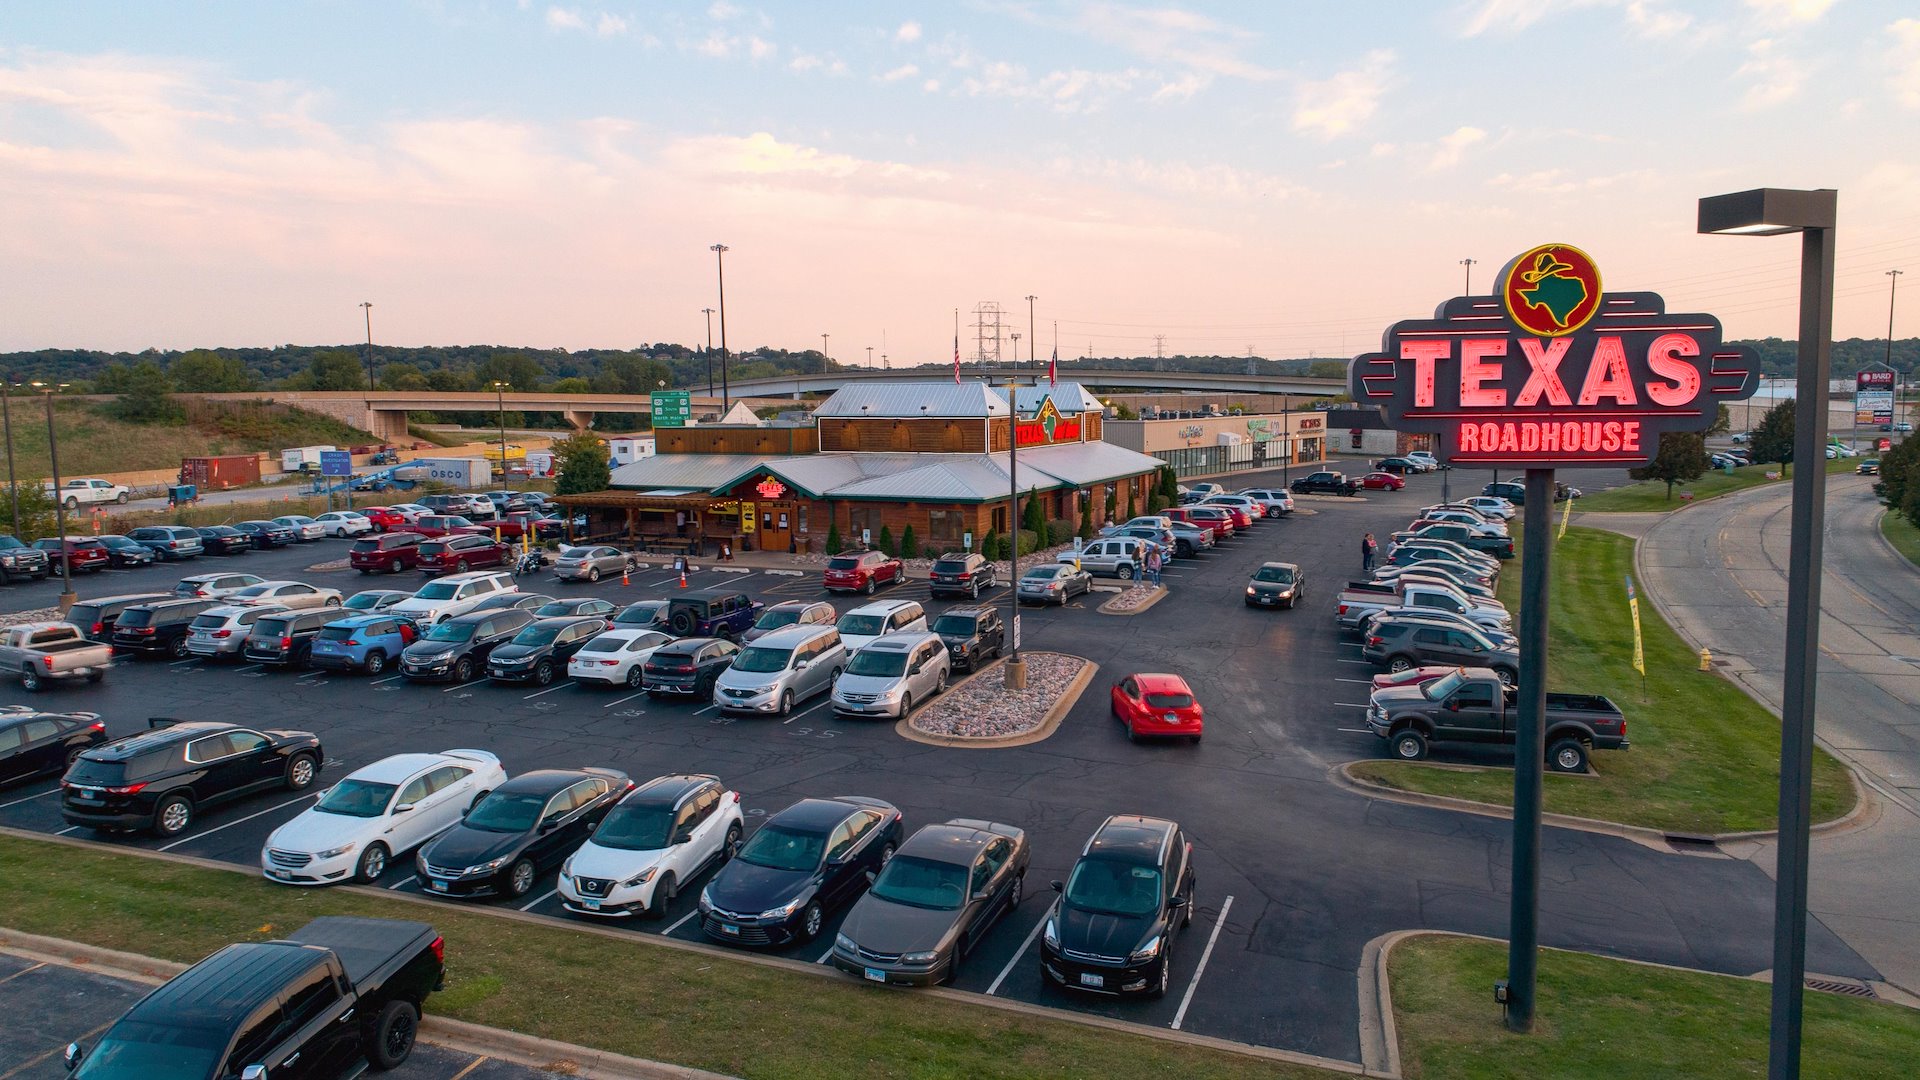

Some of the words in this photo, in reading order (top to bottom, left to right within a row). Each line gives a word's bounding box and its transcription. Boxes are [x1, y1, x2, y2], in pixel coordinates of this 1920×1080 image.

[1400, 333, 1701, 407] TEXAS
[1015, 424, 1044, 443] TEXAS
[1459, 421, 1640, 452] ROADHOUSE
[431, 470, 462, 479] OSCO
[759, 484, 783, 492] TEXAS
[788, 727, 843, 739] 35
